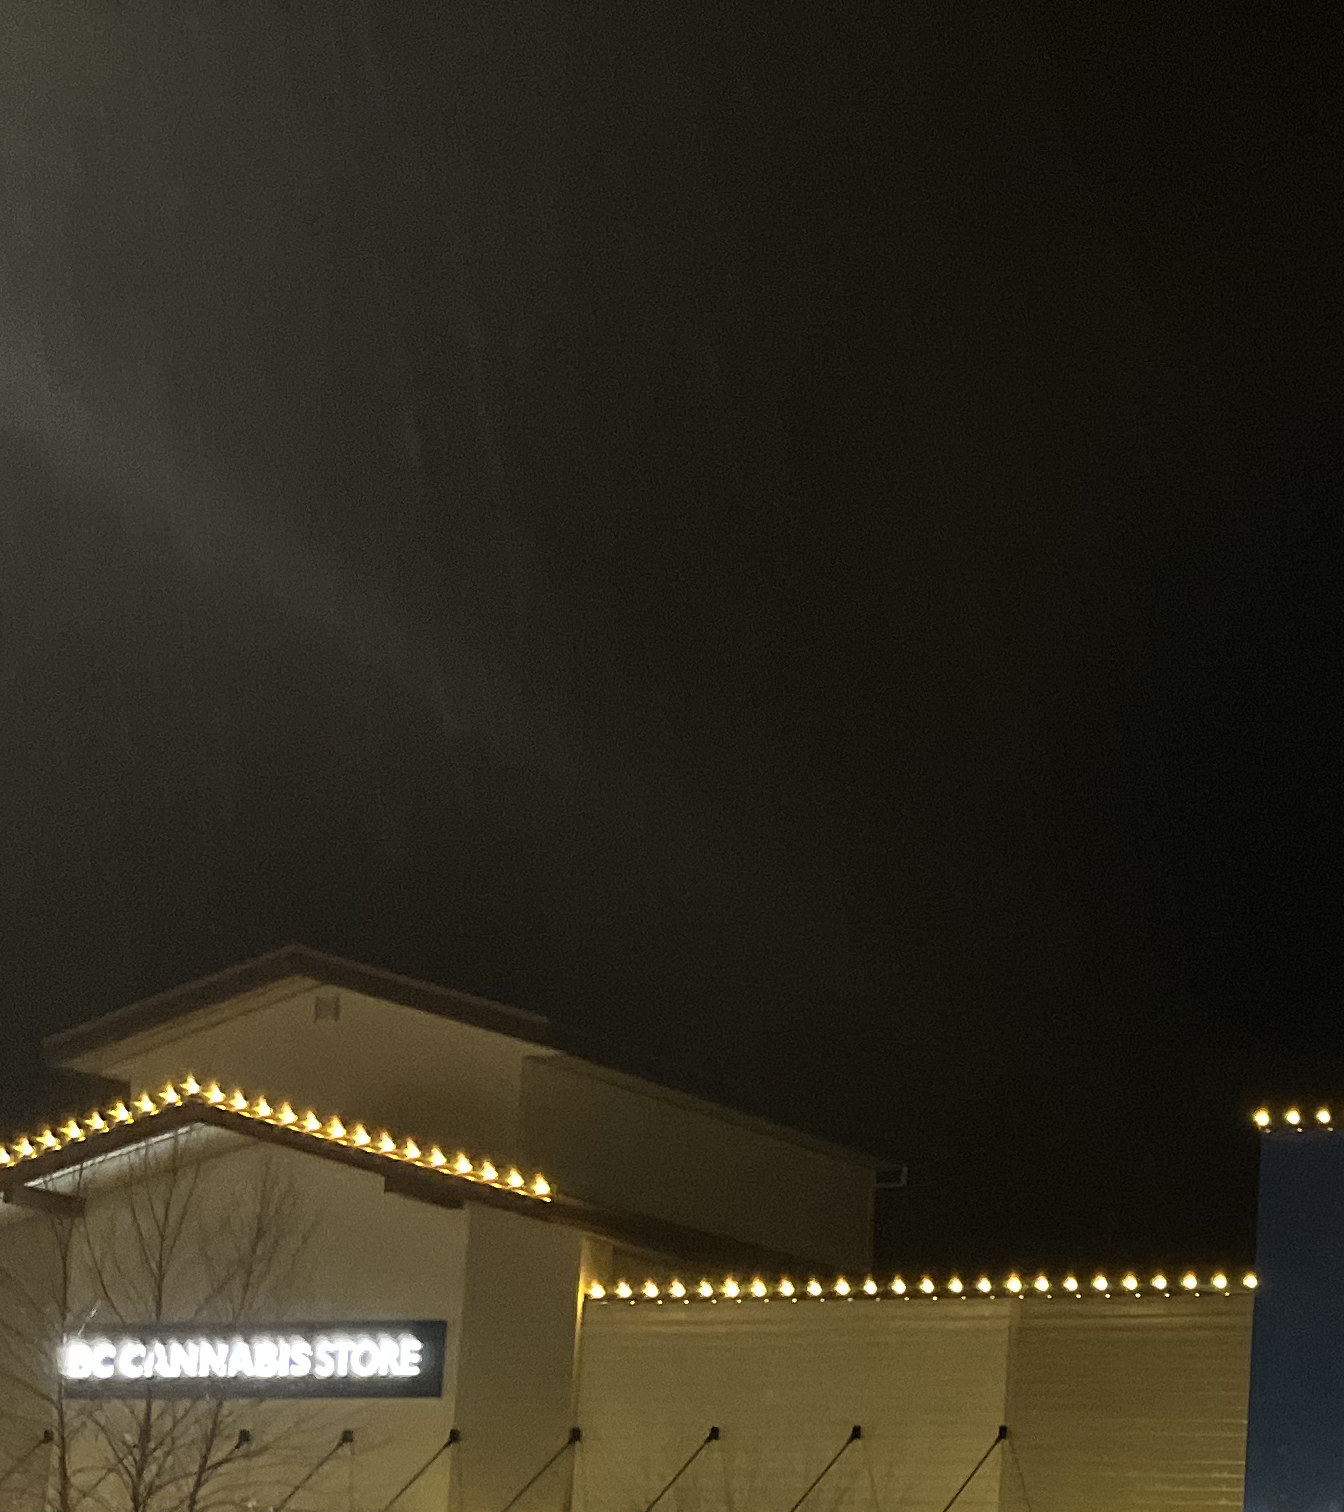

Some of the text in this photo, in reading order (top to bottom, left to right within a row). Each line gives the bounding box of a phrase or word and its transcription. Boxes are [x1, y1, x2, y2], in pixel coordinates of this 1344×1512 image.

[63, 1334, 423, 1378] BC CANNABIS STORE
